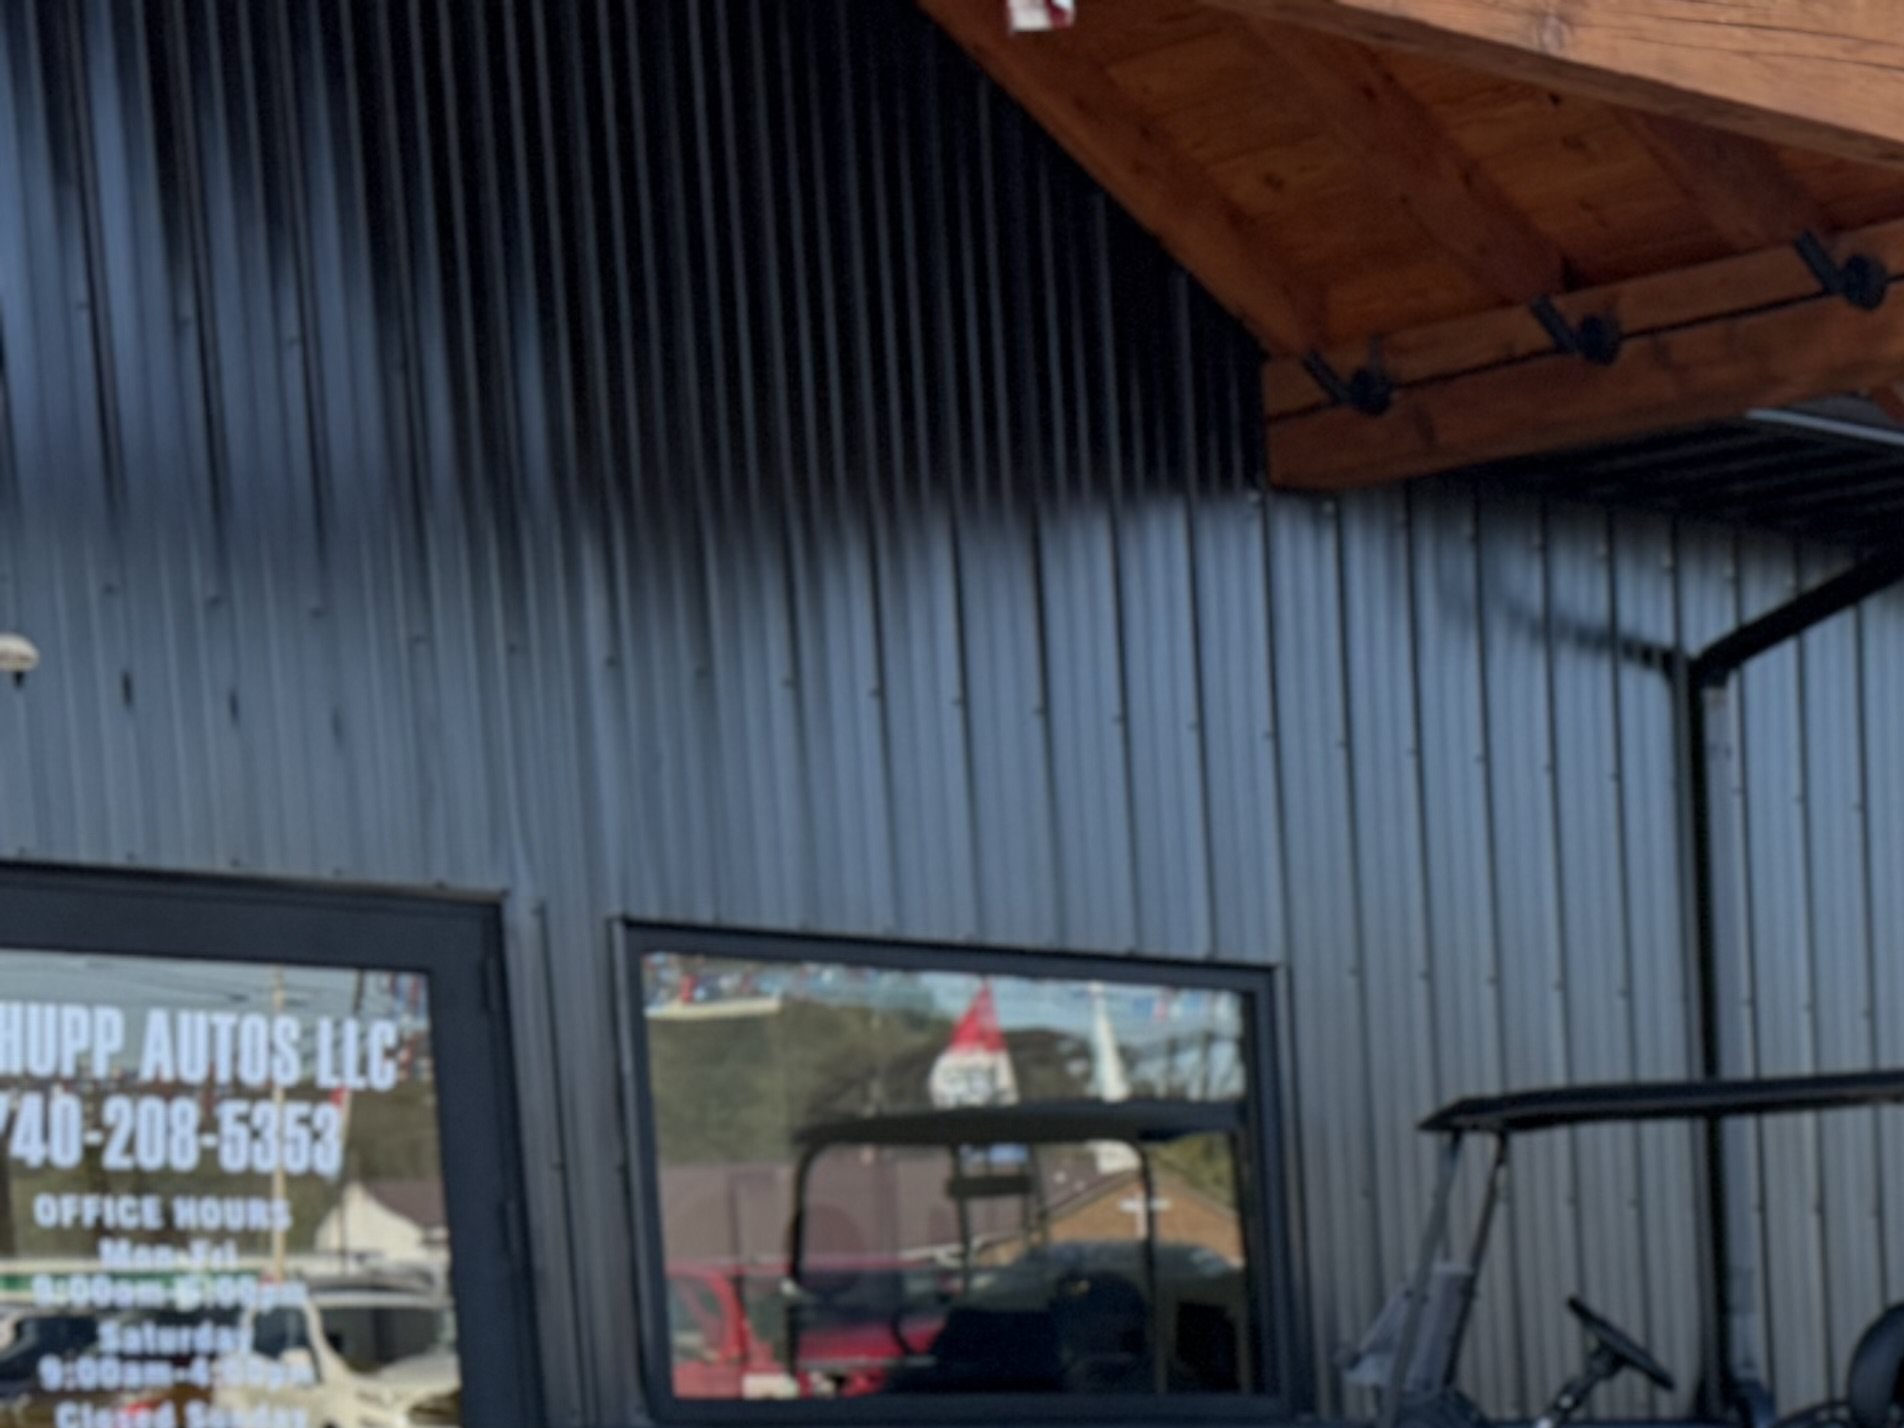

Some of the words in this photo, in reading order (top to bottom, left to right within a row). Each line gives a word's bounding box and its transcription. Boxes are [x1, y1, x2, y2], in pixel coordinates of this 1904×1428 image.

[139, 1008, 301, 1087] AUTOS
[315, 1016, 399, 1091] LLC
[33, 1193, 164, 1231] OFFICE
[172, 1196, 292, 1232] HOURS
[99, 1318, 253, 1353] Saturday
